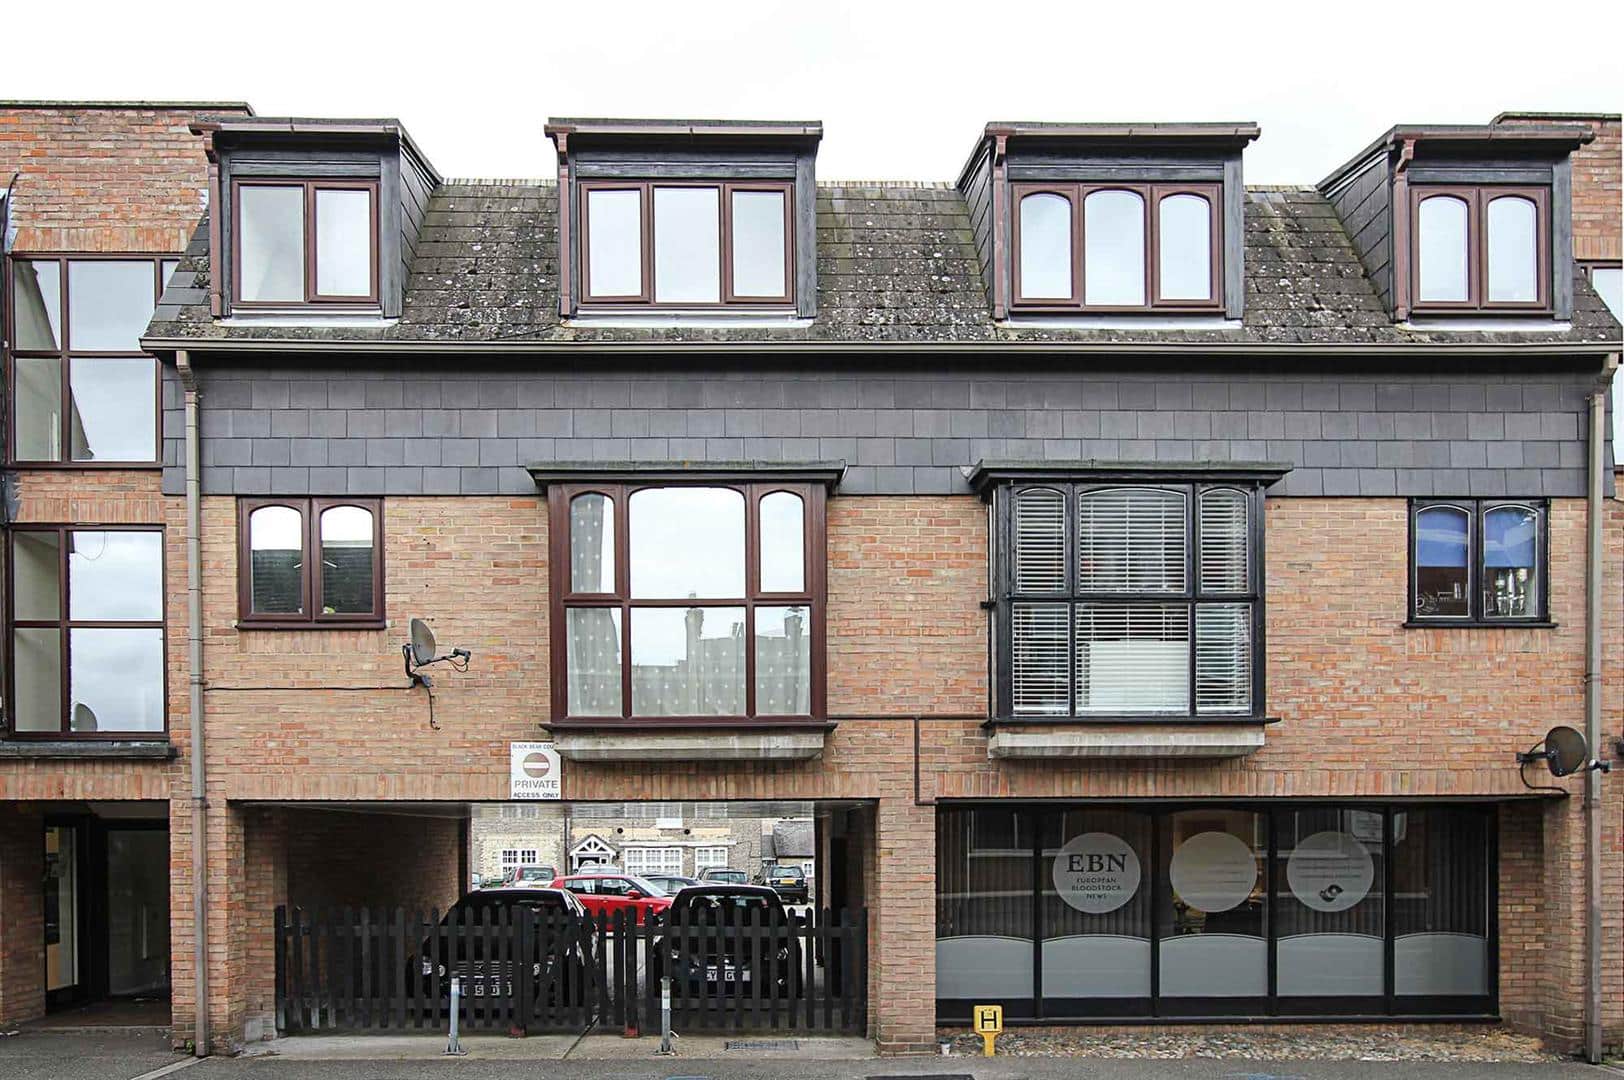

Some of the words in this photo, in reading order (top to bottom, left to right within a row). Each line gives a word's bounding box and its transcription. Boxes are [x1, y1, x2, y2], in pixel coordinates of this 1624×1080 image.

[514, 780, 559, 788] PRIVATE
[1066, 854, 1127, 872] EBN
[981, 1011, 997, 1029] H
